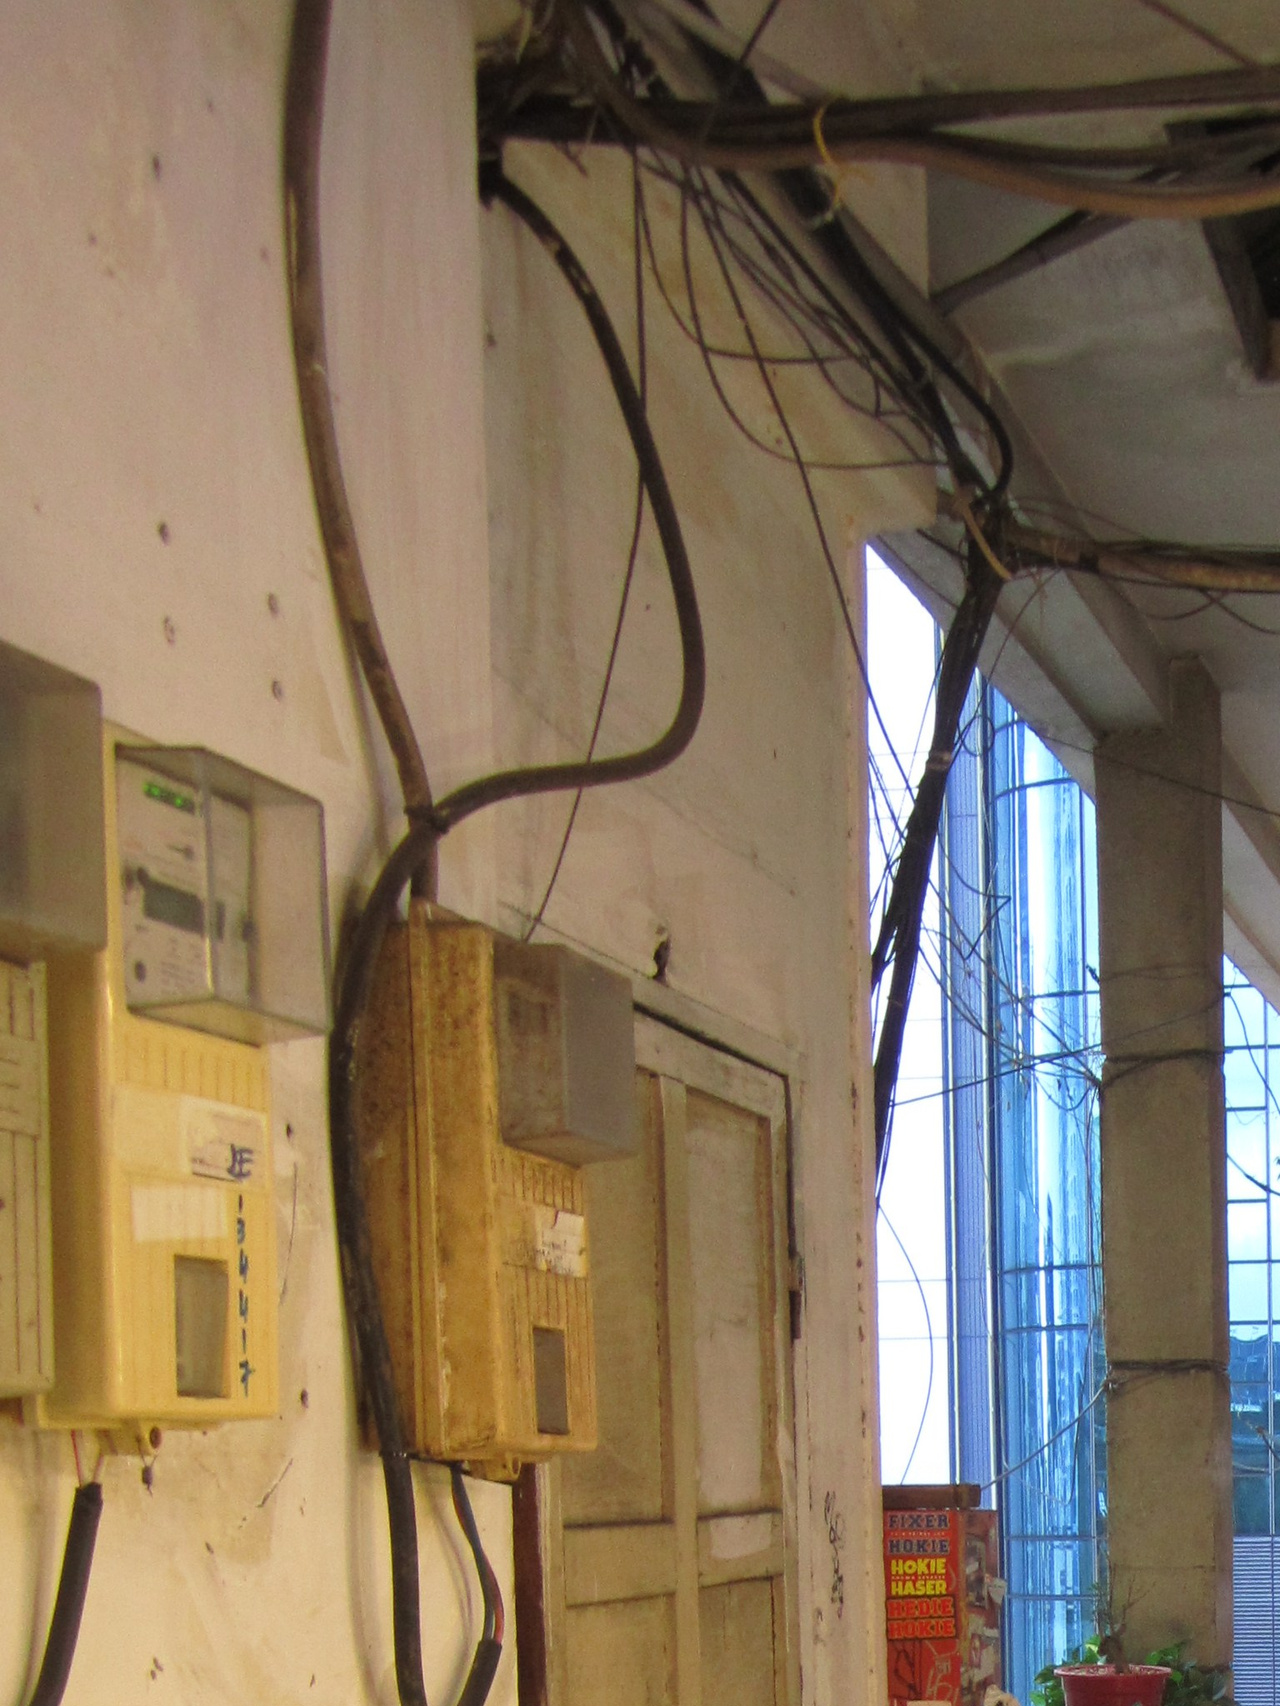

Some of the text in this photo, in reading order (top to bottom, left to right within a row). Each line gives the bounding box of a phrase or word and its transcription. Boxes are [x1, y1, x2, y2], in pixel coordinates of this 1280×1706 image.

[888, 1513, 949, 1529] FIXER
[888, 1539, 949, 1554] HOKIE
[891, 1558, 946, 1575] HOKIE
[891, 1580, 947, 1596] HASER
